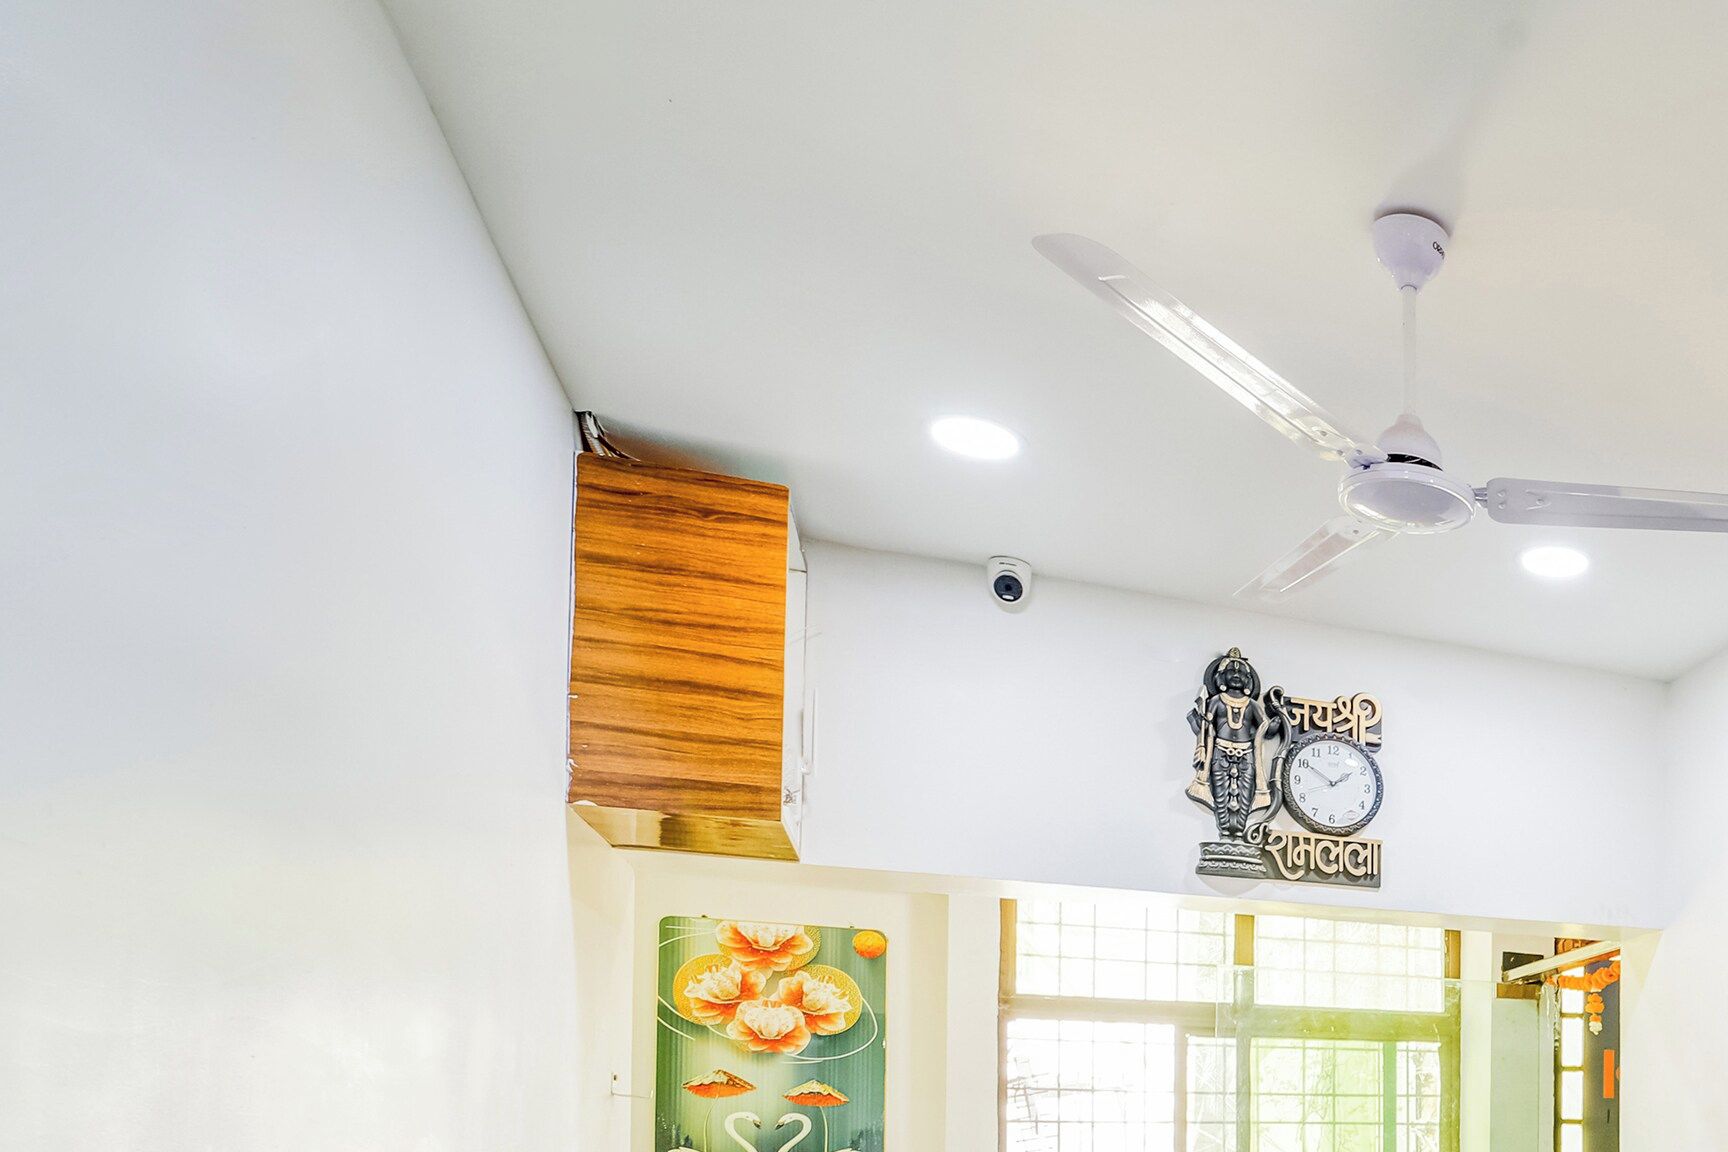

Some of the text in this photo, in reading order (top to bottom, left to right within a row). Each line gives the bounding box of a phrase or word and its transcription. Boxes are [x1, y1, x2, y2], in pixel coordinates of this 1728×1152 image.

[1311, 747, 1321, 758] 11
[1328, 745, 1340, 756] 12
[1298, 759, 1309, 769] 10
[1360, 766, 1367, 776] 2
[1294, 775, 1301, 785] 9
[1364, 784, 1371, 794] 3
[1299, 793, 1306, 803] 8
[1359, 800, 1365, 810] 4
[1311, 807, 1318, 817] 7
[1328, 813, 1336, 825] 6
[1265, 830, 1382, 880] रामलला
